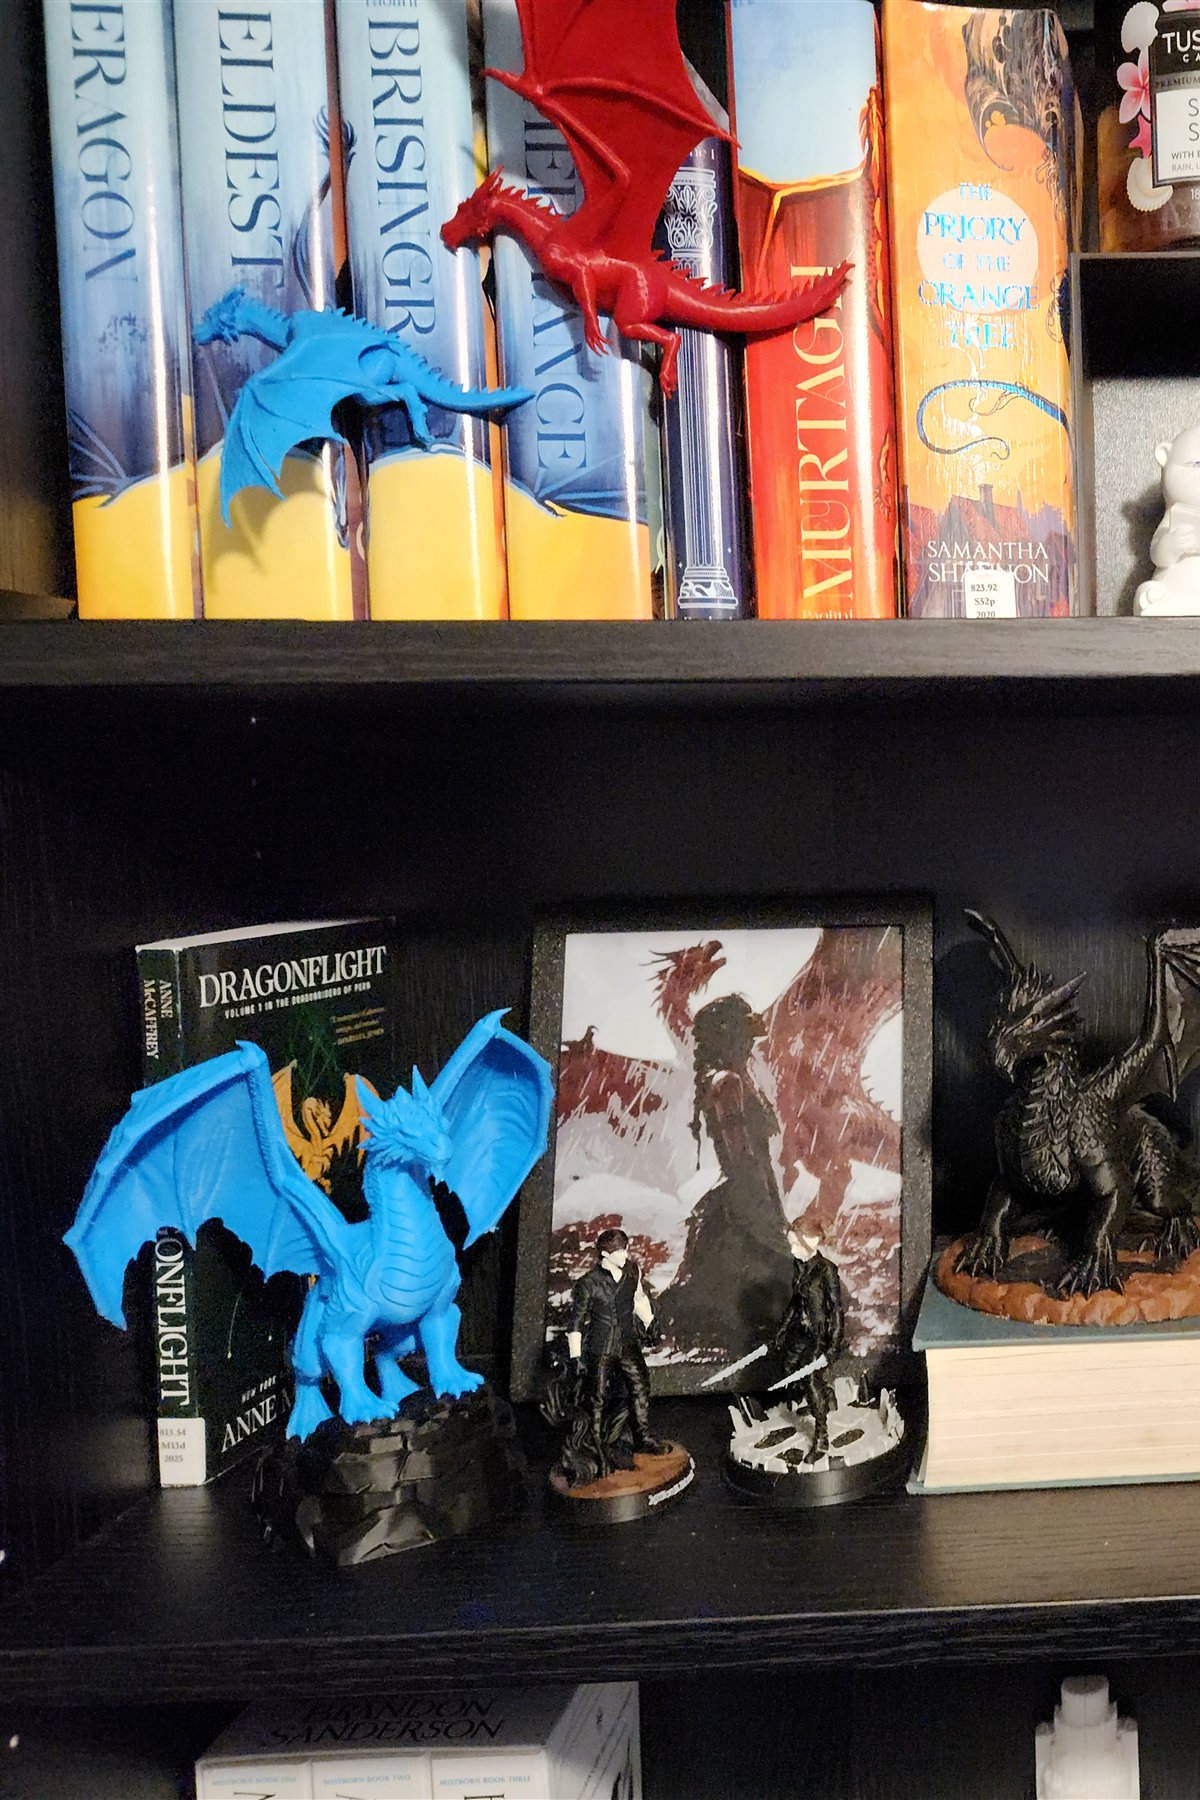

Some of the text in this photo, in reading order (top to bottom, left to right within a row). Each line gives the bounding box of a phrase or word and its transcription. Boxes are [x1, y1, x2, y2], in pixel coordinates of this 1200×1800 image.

[1155, 76, 1200, 89] PREMIUM
[71, 3, 138, 283] ERAGON
[218, 9, 286, 289] ELDEST
[1171, 151, 1195, 161] WITH
[368, 17, 437, 335] BRISINGR
[1171, 163, 1194, 172] RAIN,
[959, 182, 993, 200] THE
[1190, 188, 1200, 200] 18
[924, 211, 1026, 245] PRIORY
[943, 253, 1011, 272] OF THE
[918, 280, 1040, 310] ORANGE
[945, 321, 1017, 348] TREE
[927, 540, 1049, 560] SAMANTHA
[971, 583, 998, 593] 823.92
[974, 597, 996, 607] S52p
[199, 945, 388, 1009] DRAGONFLIGHT
[160, 979, 173, 1018] ANNE
[225, 1003, 256, 1020] VOLUME
[155, 1228, 190, 1406] ONFLIGHT
[221, 1394, 277, 1453] ANNE
[270, 1718, 504, 1745] SANDERSON
[323, 1777, 365, 1785] MISTBORN
[439, 1778, 481, 1786] MISTBORN
